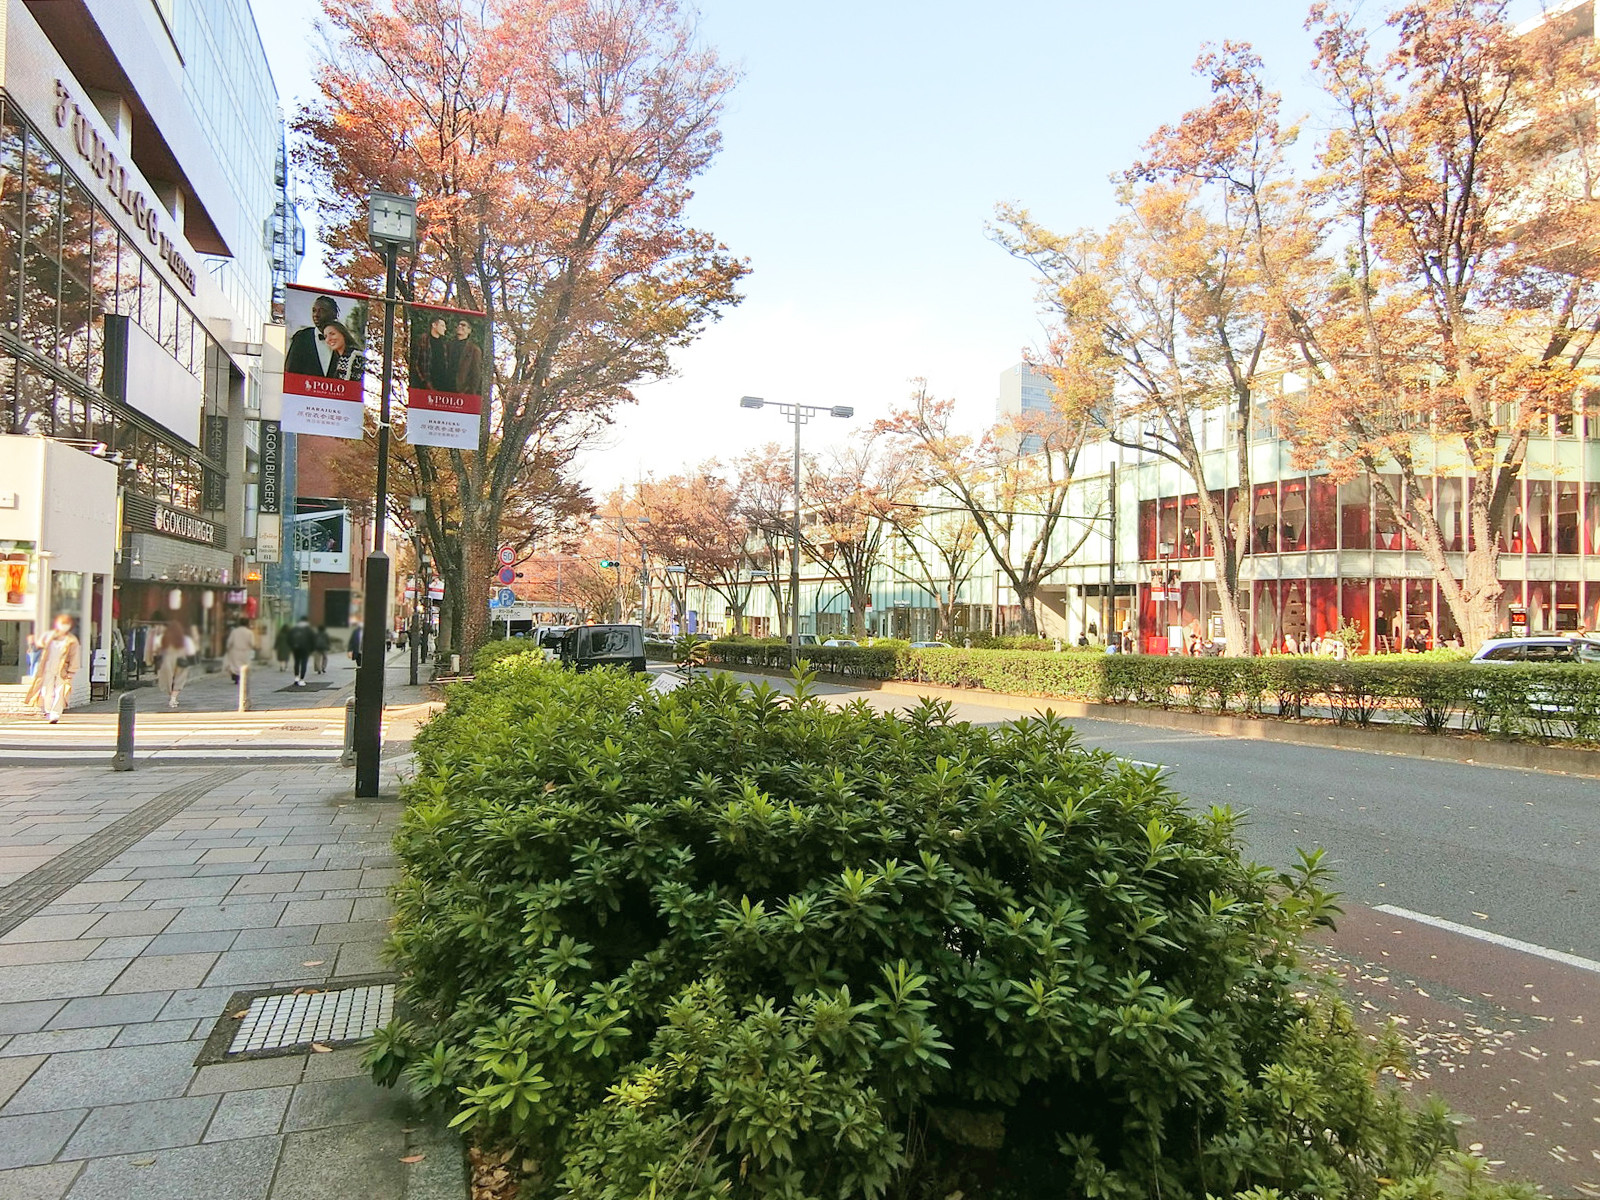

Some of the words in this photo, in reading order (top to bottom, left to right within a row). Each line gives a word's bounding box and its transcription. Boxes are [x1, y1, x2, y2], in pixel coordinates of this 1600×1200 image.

[314, 382, 345, 394] POLO
[435, 395, 464, 407] POLO
[503, 552, 513, 561] 50
